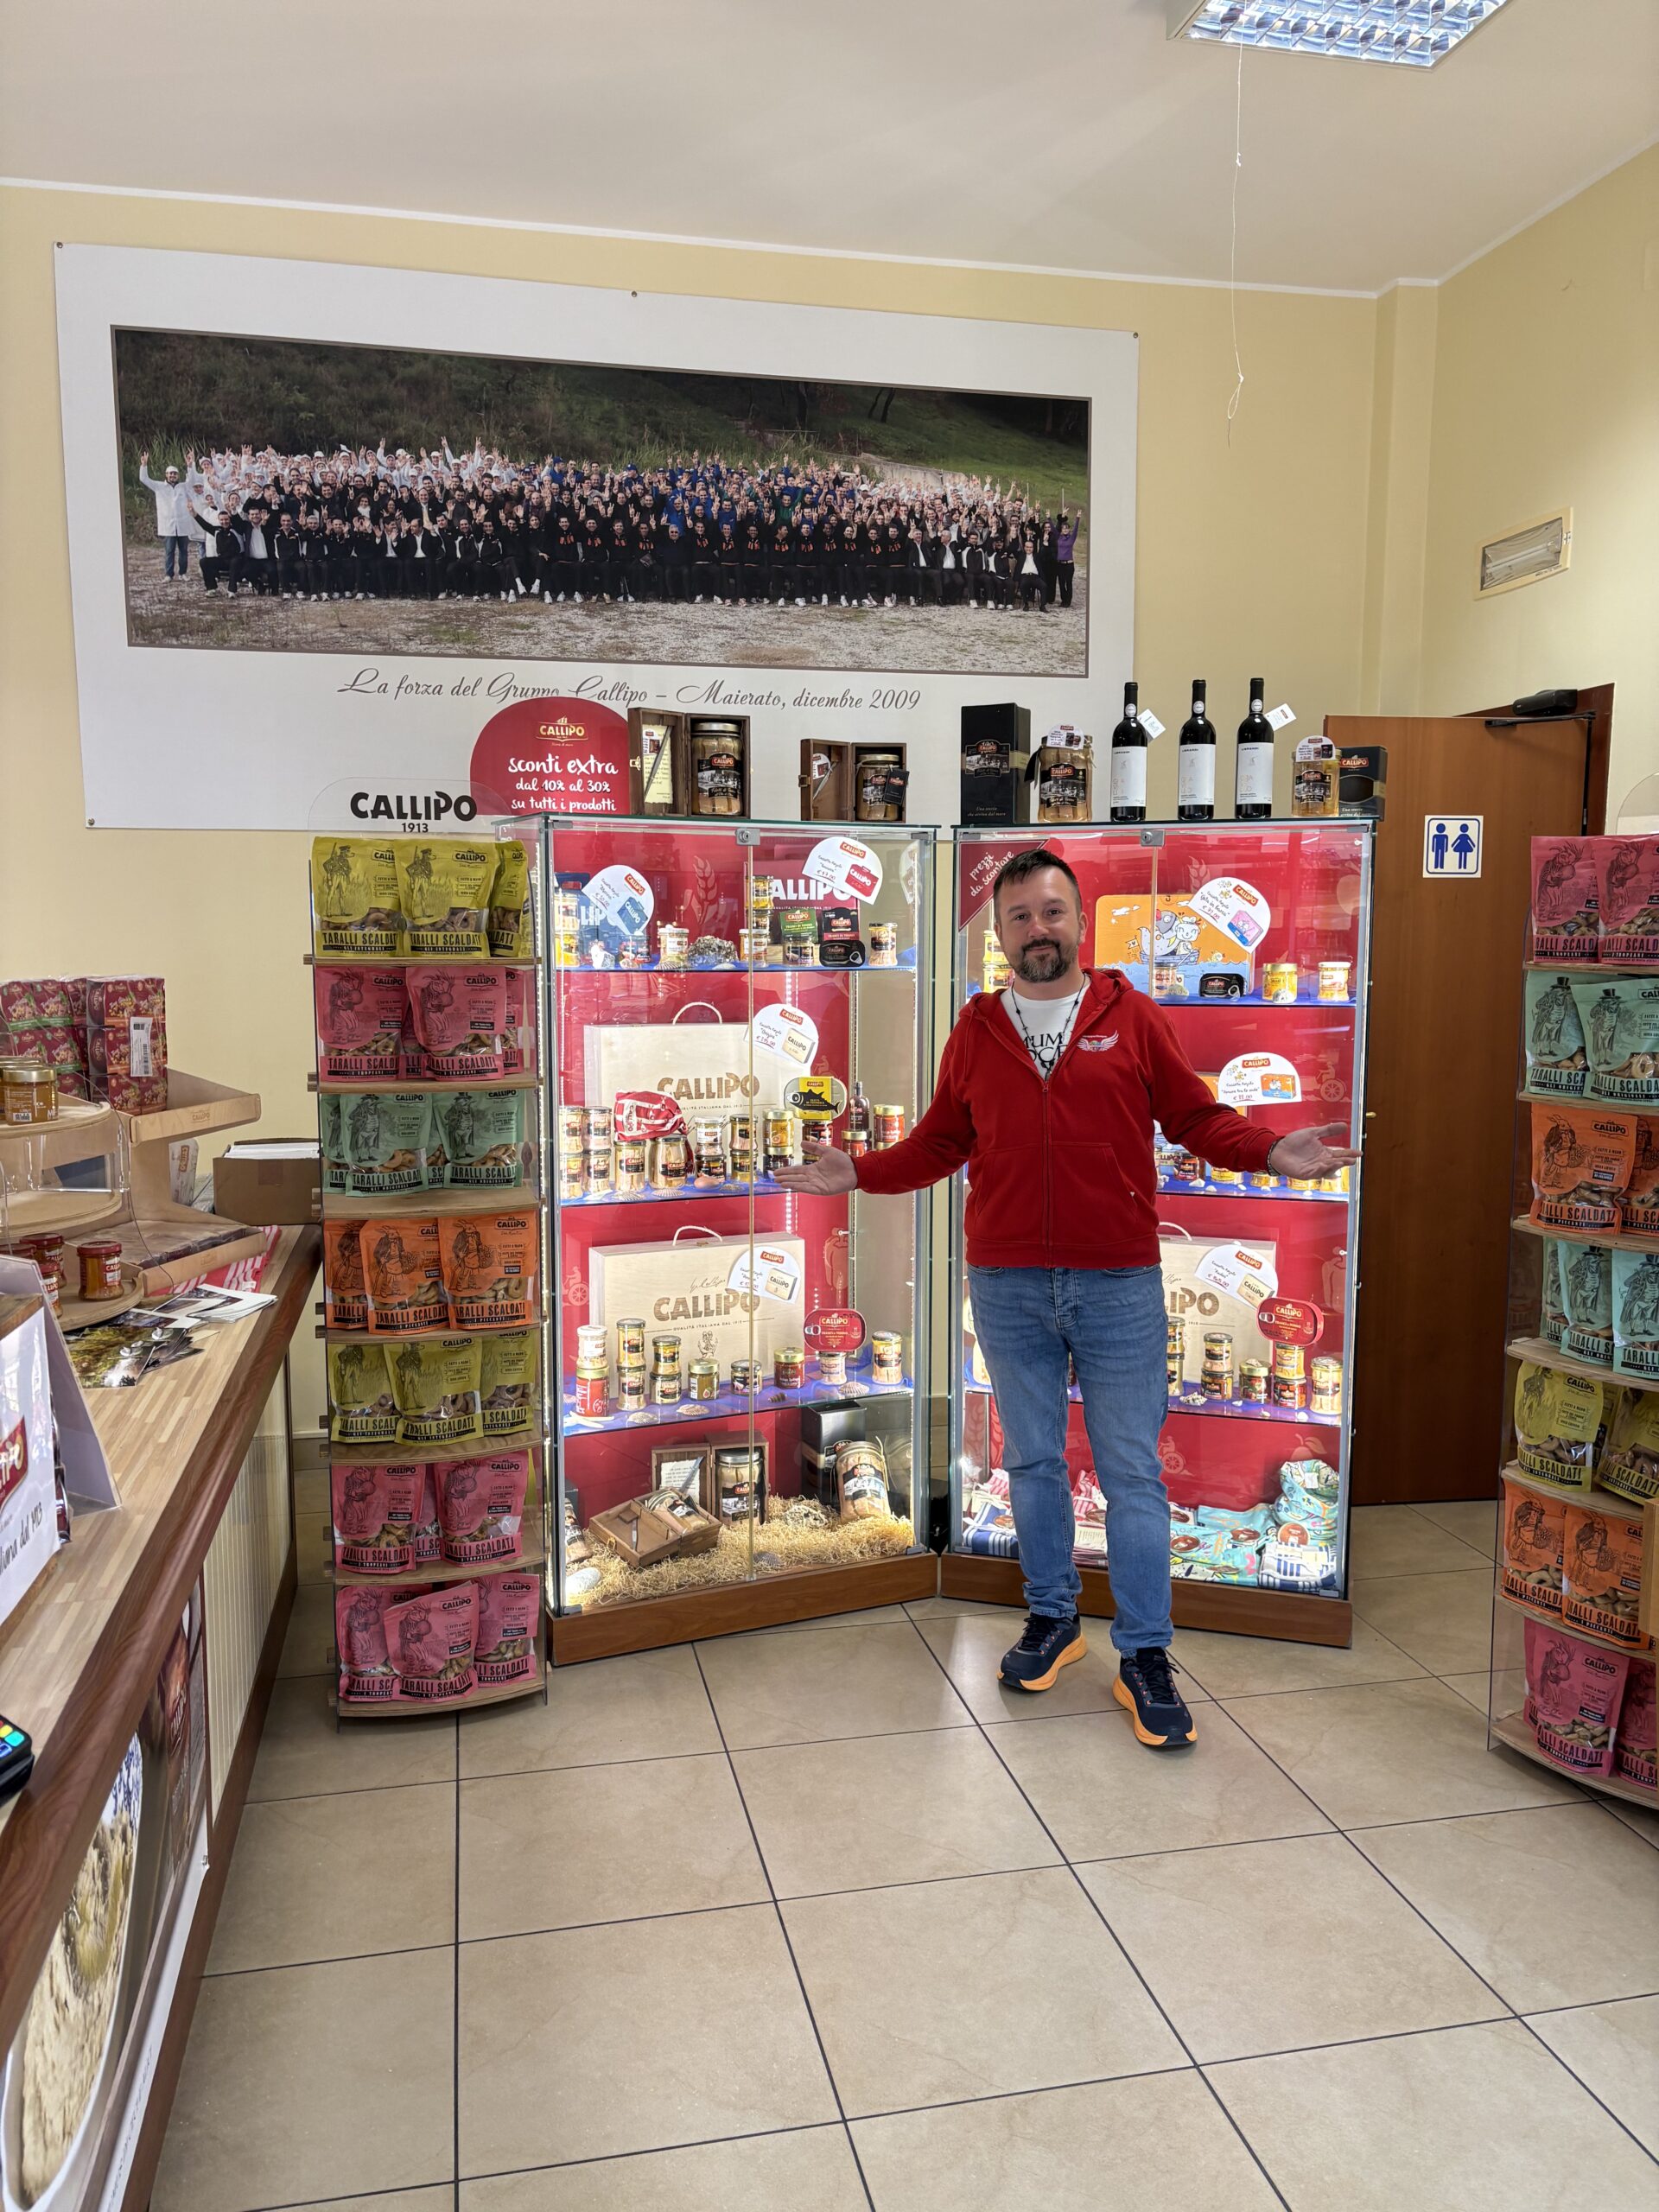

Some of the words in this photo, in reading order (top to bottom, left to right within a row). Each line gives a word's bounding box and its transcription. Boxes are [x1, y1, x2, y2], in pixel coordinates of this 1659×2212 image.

[338, 668, 388, 694] La
[394, 675, 442, 701] forza
[451, 677, 483, 696] del
[568, 676, 647, 708] Callipo
[677, 679, 785, 710] Maierato,
[793, 689, 863, 709] dicembre
[868, 689, 920, 710] 2009
[539, 724, 585, 737] CALLIPO
[508, 753, 563, 776] sconti
[567, 756, 619, 776] extra
[516, 779, 538, 792] dal
[542, 779, 565, 793] 10%
[569, 779, 584, 792] al
[587, 779, 611, 793] 30%
[350, 791, 477, 822] CALLIPO
[511, 798, 527, 810] su
[530, 798, 557, 811] tutti
[569, 798, 617, 812] prodotti
[402, 823, 429, 834] 1913
[374, 851, 395, 861] CALL
[454, 852, 486, 862] CALLIPO
[842, 843, 865, 857] CALLIPO
[969, 852, 995, 881] prezzi
[969, 884, 983, 897] da
[982, 850, 1014, 886] scontare
[626, 875, 644, 893] CALLIPO
[849, 868, 872, 887] CALLIPO
[1236, 887, 1257, 905] CALLIPO
[323, 931, 358, 945] TARALLI
[443, 932, 482, 945] SCALDATI
[373, 977, 404, 986] CALLIPO
[466, 976, 497, 985] CALLIPO
[781, 1010, 802, 1023] CALLIPO
[787, 1036, 807, 1051] CALLIPO
[328, 1058, 363, 1071] TARALLI
[459, 1056, 497, 1070] SCALDATI
[657, 1071, 760, 1100] CALLIPO
[1619, 1077, 1659, 1093] SCALDA
[488, 1090, 517, 1098] CALLIPO
[1593, 1123, 1626, 1135] CALLIPO
[353, 1173, 385, 1186] TARALLI
[451, 1166, 482, 1179] TARALLI
[1567, 1205, 1616, 1223] SCALDATI
[497, 1219, 527, 1229] CALLIPO
[420, 1227, 439, 1236] CALL
[762, 1252, 783, 1262] CALLIPO
[1237, 1253, 1262, 1268] CALLIPO
[770, 1276, 790, 1288] CALLIPO
[1244, 1281, 1265, 1298] CALLIPO
[488, 1301, 525, 1316] SCALDATI
[653, 1287, 760, 1322] CALLIPO
[376, 1310, 410, 1325] TARALLI
[1275, 1306, 1302, 1318] CALLIPO
[442, 1338, 473, 1347] CALLIPO
[1569, 1332, 1601, 1352] TARALLI
[1567, 1376, 1595, 1393] CALLIPO
[490, 1408, 527, 1422] SCALDATI
[436, 1416, 474, 1433] SCALDATI
[491, 1462, 520, 1471] CALLIPO
[1540, 1458, 1582, 1479] SCALDATI
[476, 1536, 514, 1555] SCALDATI
[372, 1548, 410, 1561] SCALDATI
[502, 1583, 531, 1592] CALLIPO
[442, 1598, 472, 1611] CALLIPO
[490, 1660, 528, 1676] SCALDATI
[1585, 1656, 1617, 1675] CALLIPO
[402, 1679, 434, 1693] TARALLI
[1559, 1738, 1603, 1763] SCALDATI
